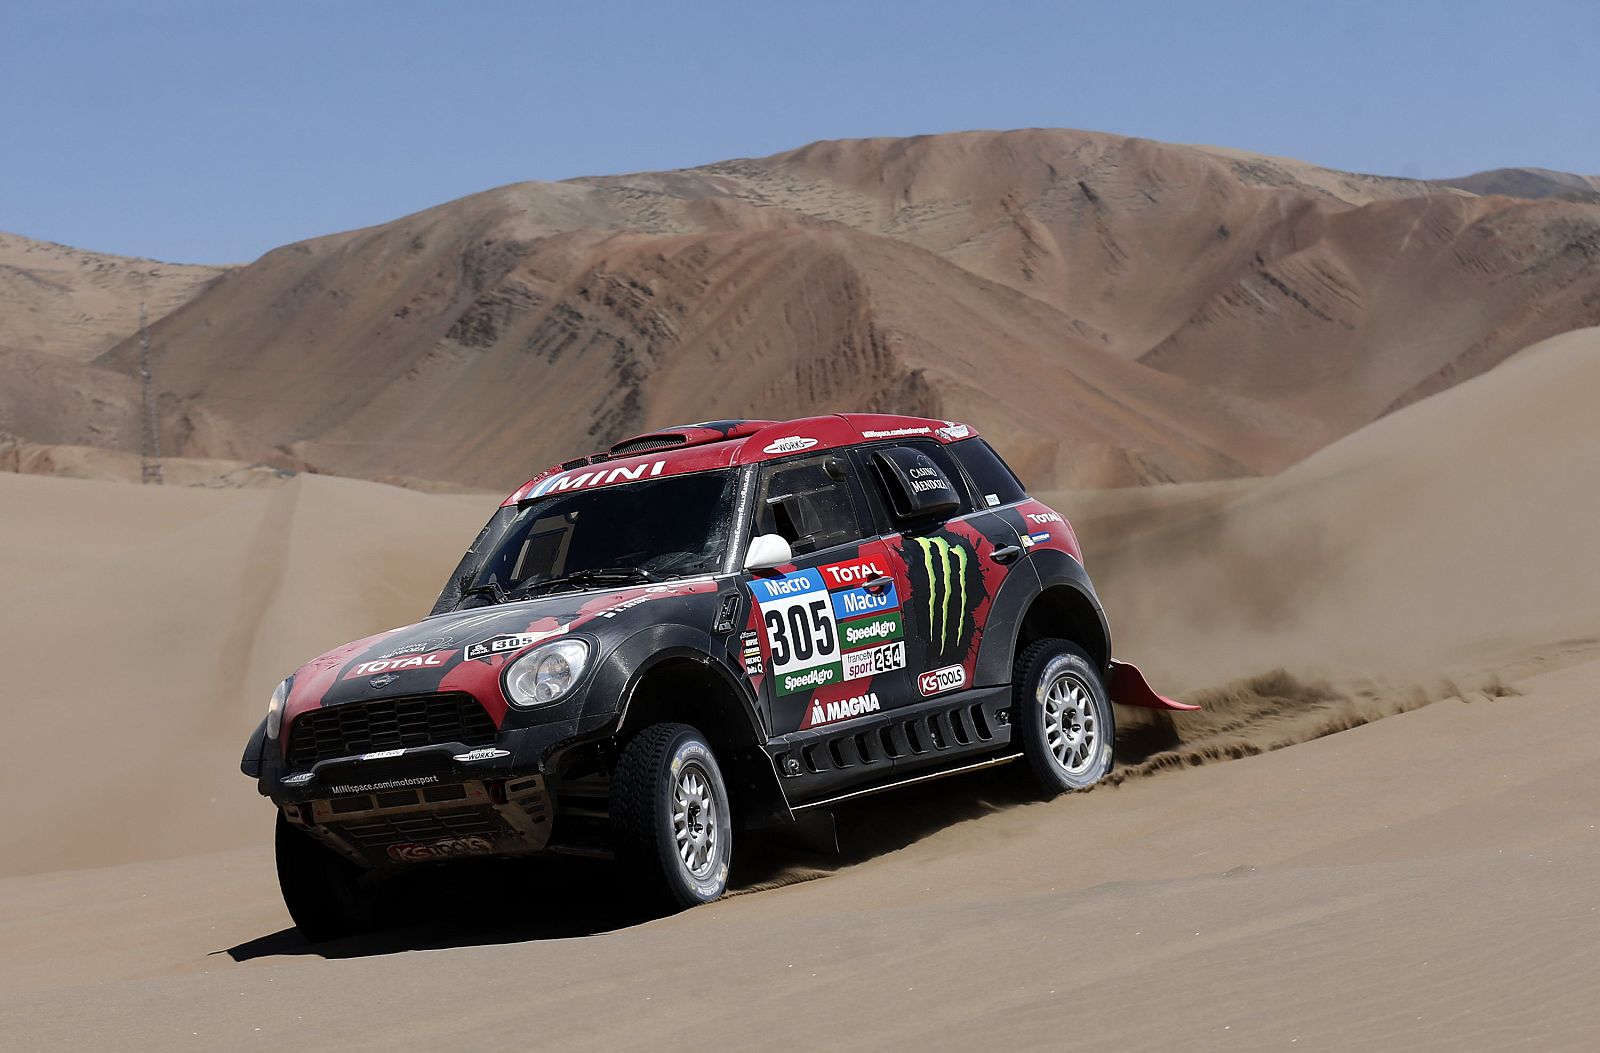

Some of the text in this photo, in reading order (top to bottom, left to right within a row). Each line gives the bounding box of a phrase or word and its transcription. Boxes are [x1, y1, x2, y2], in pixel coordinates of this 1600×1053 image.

[778, 440, 805, 452] WORKS
[548, 461, 665, 492] MINI
[910, 467, 937, 478] CASINO
[911, 479, 948, 492] MENDOZA
[1027, 513, 1062, 524] TOTAL
[826, 562, 884, 583] TOTAL
[764, 576, 811, 597] Macro
[843, 592, 887, 613] Macro
[765, 600, 835, 667] 305
[846, 621, 896, 643] SpeedAgro
[496, 637, 533, 648] 305
[356, 655, 441, 675] TOTAL
[848, 650, 873, 663] francetv
[849, 660, 873, 678] sport
[785, 669, 833, 691] SpeedAgro
[827, 693, 880, 721] MAGNA
[469, 751, 495, 760] WORKS
[332, 774, 439, 794] MINIspace.com/motorsport
